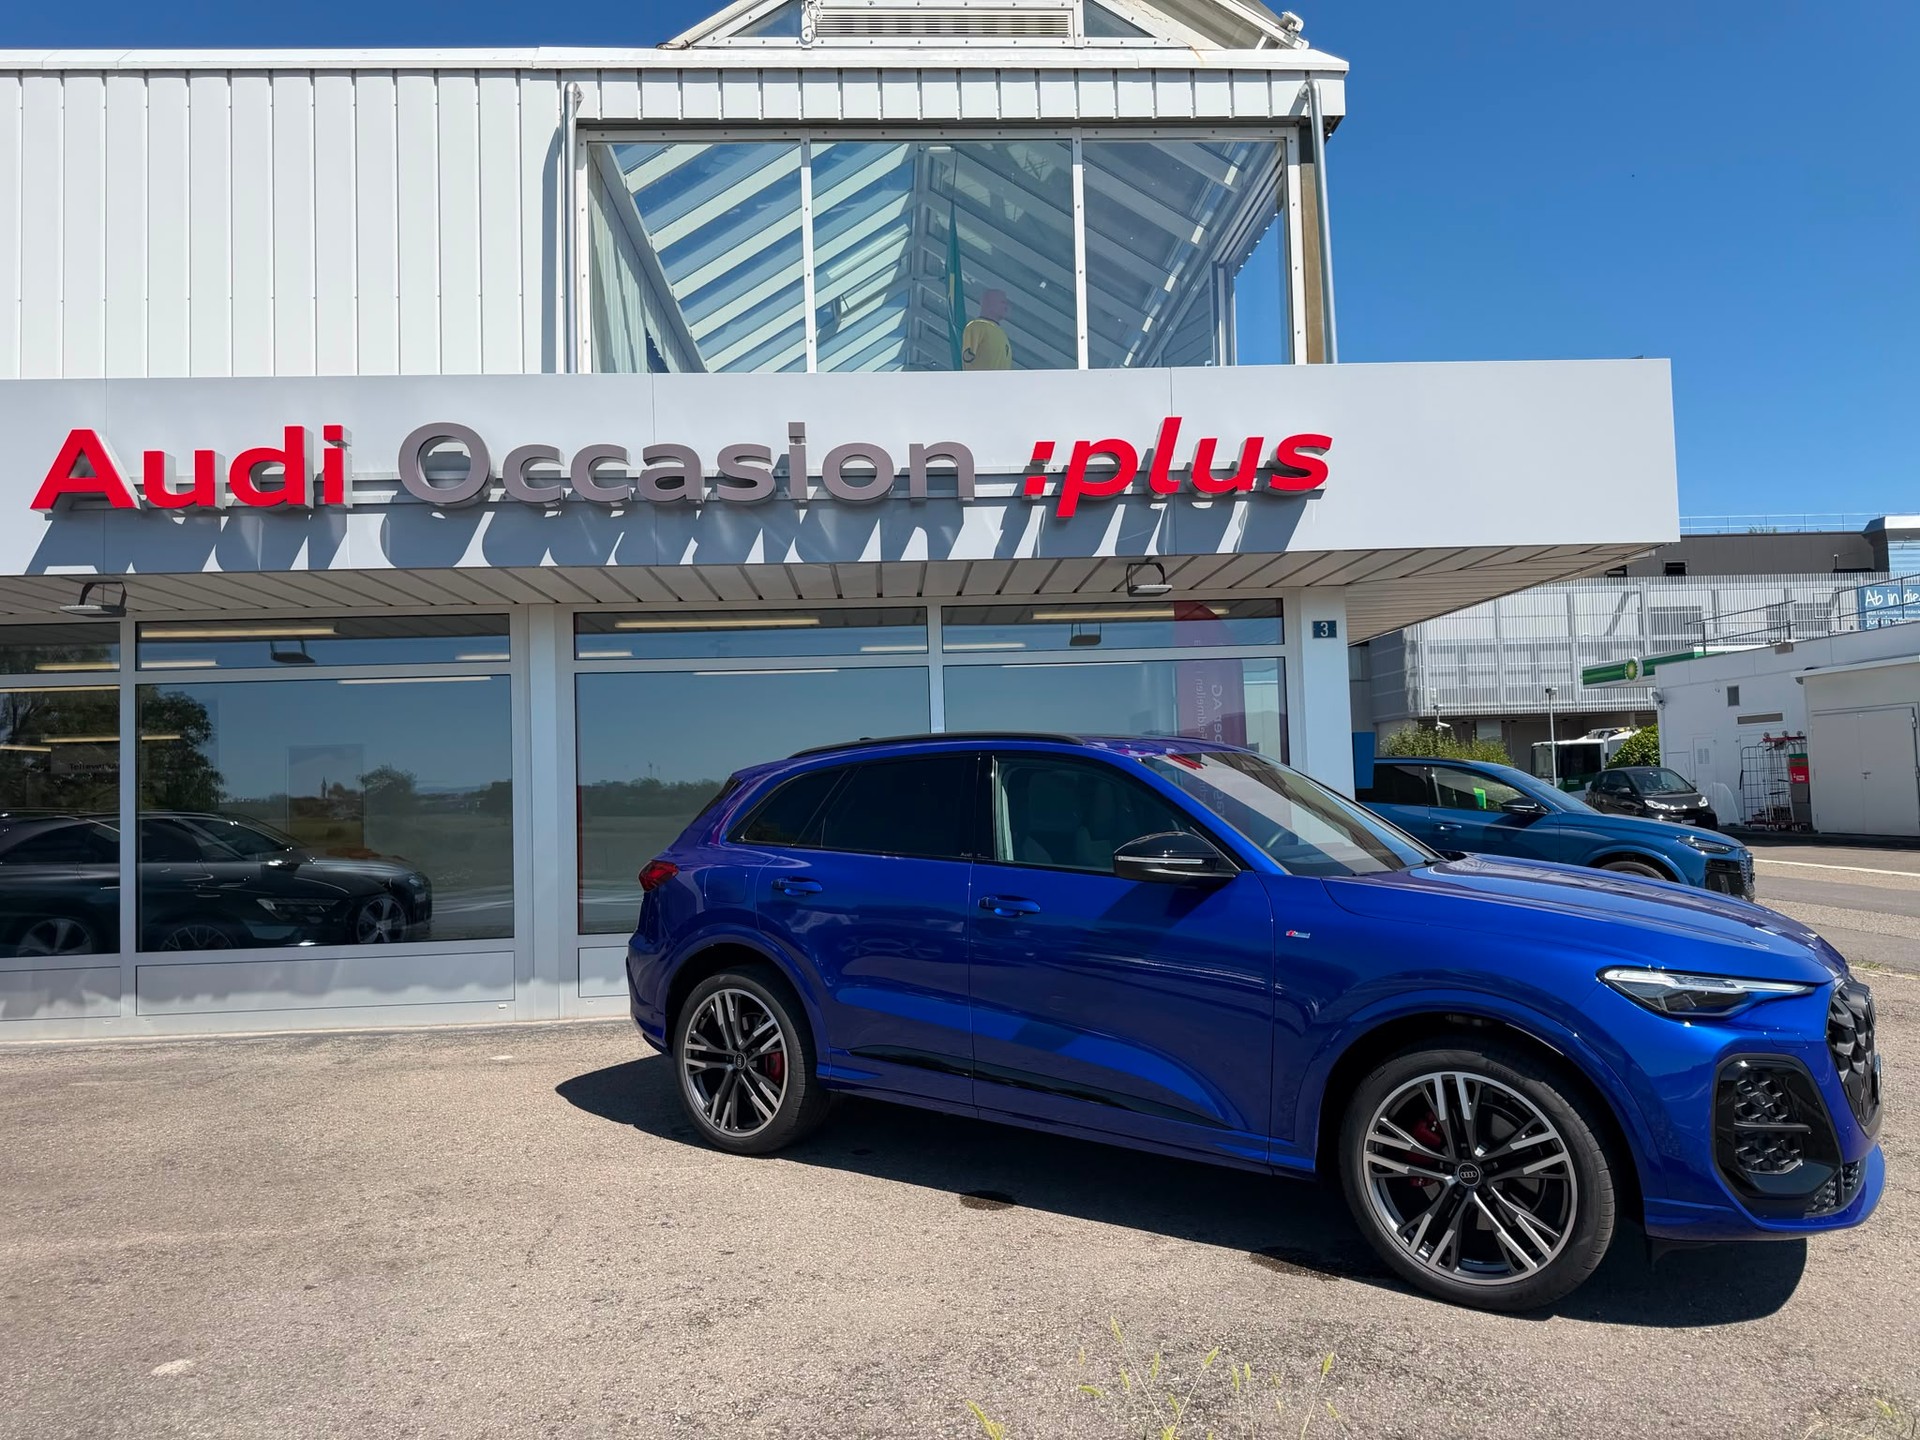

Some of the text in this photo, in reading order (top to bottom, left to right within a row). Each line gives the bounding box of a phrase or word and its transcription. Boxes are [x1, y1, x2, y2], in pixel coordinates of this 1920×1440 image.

[30, 417, 1333, 517] Audi Occasion :plus
[1865, 589, 1884, 606] Ab
[1887, 589, 1900, 606] in
[1320, 621, 1329, 637] 3
